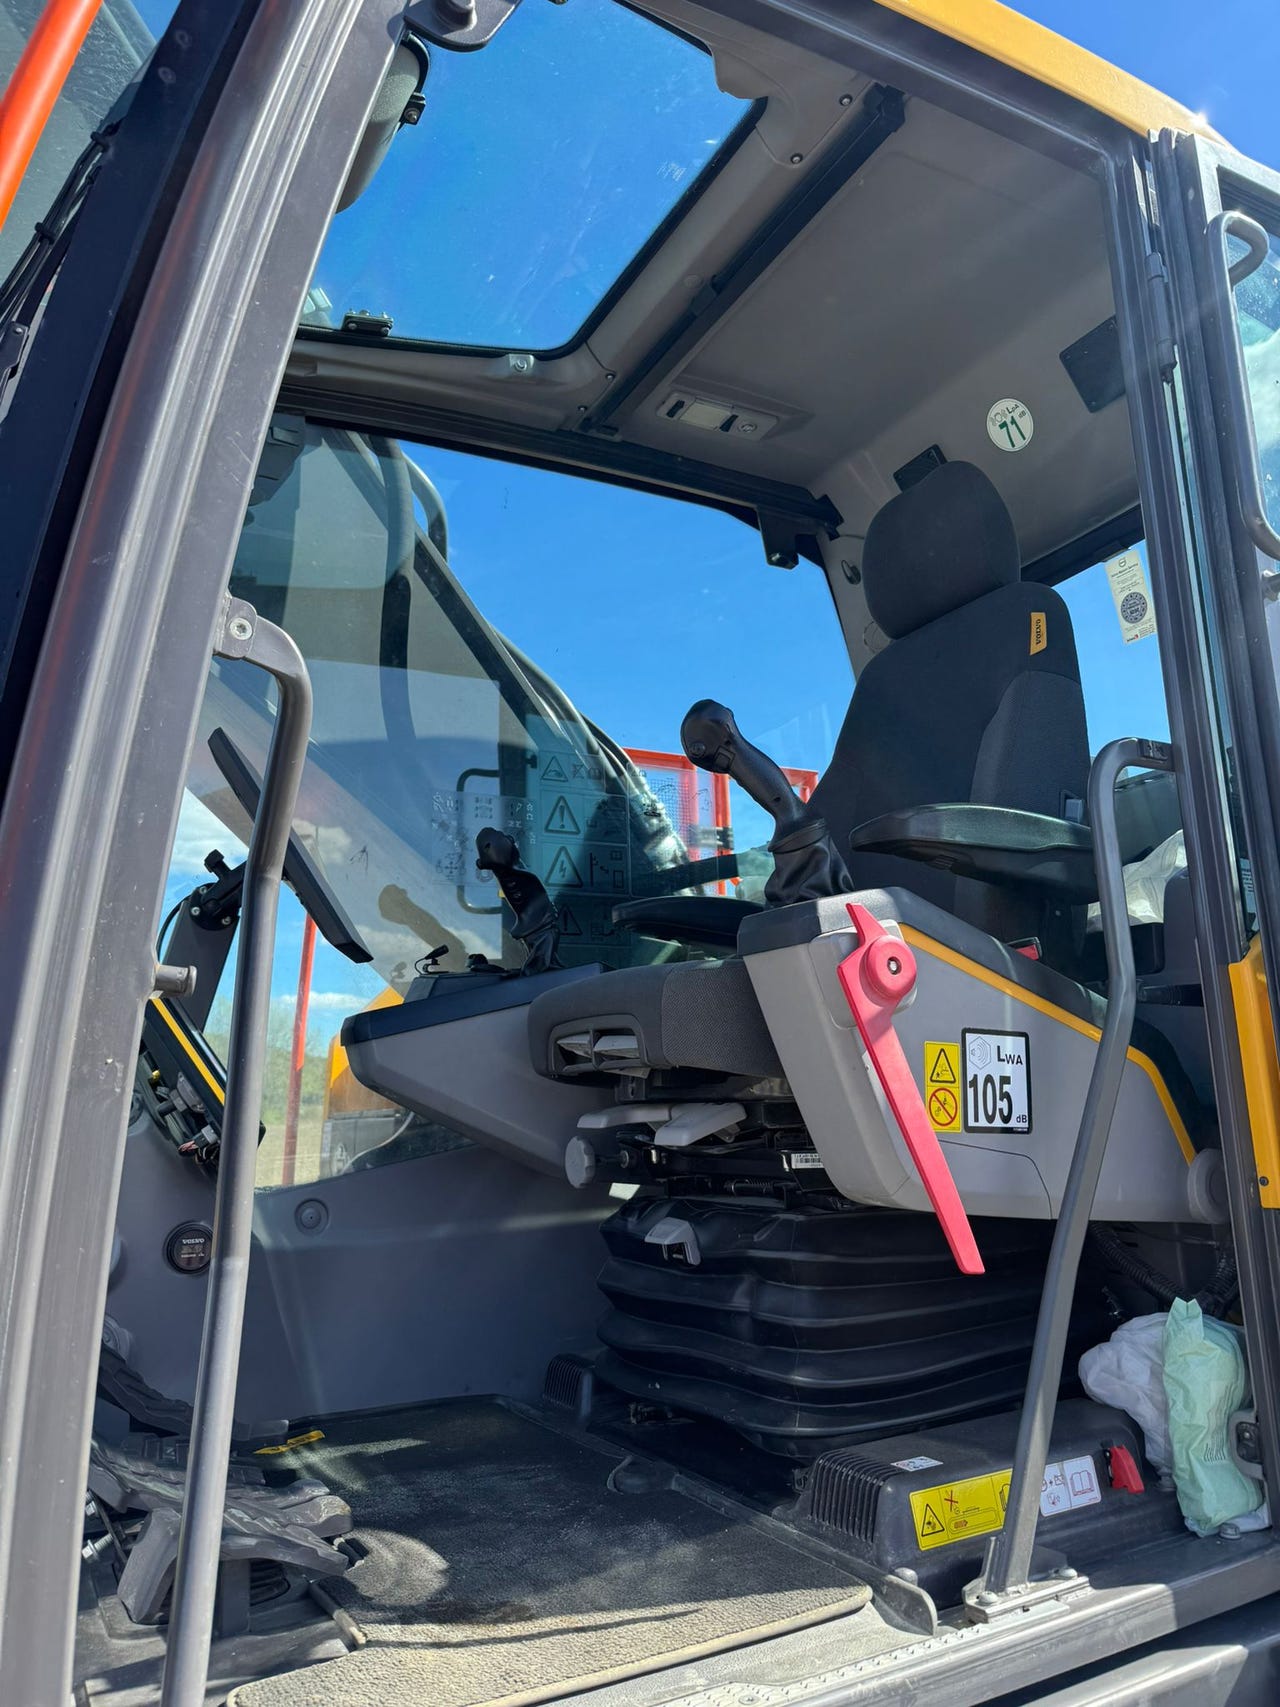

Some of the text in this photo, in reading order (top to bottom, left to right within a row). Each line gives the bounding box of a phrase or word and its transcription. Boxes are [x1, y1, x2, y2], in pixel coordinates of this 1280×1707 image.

[998, 415, 1026, 448] 71
[997, 1045, 1023, 1065] LWA
[968, 1073, 1013, 1124] 105
[1016, 1114, 1028, 1123] dB
